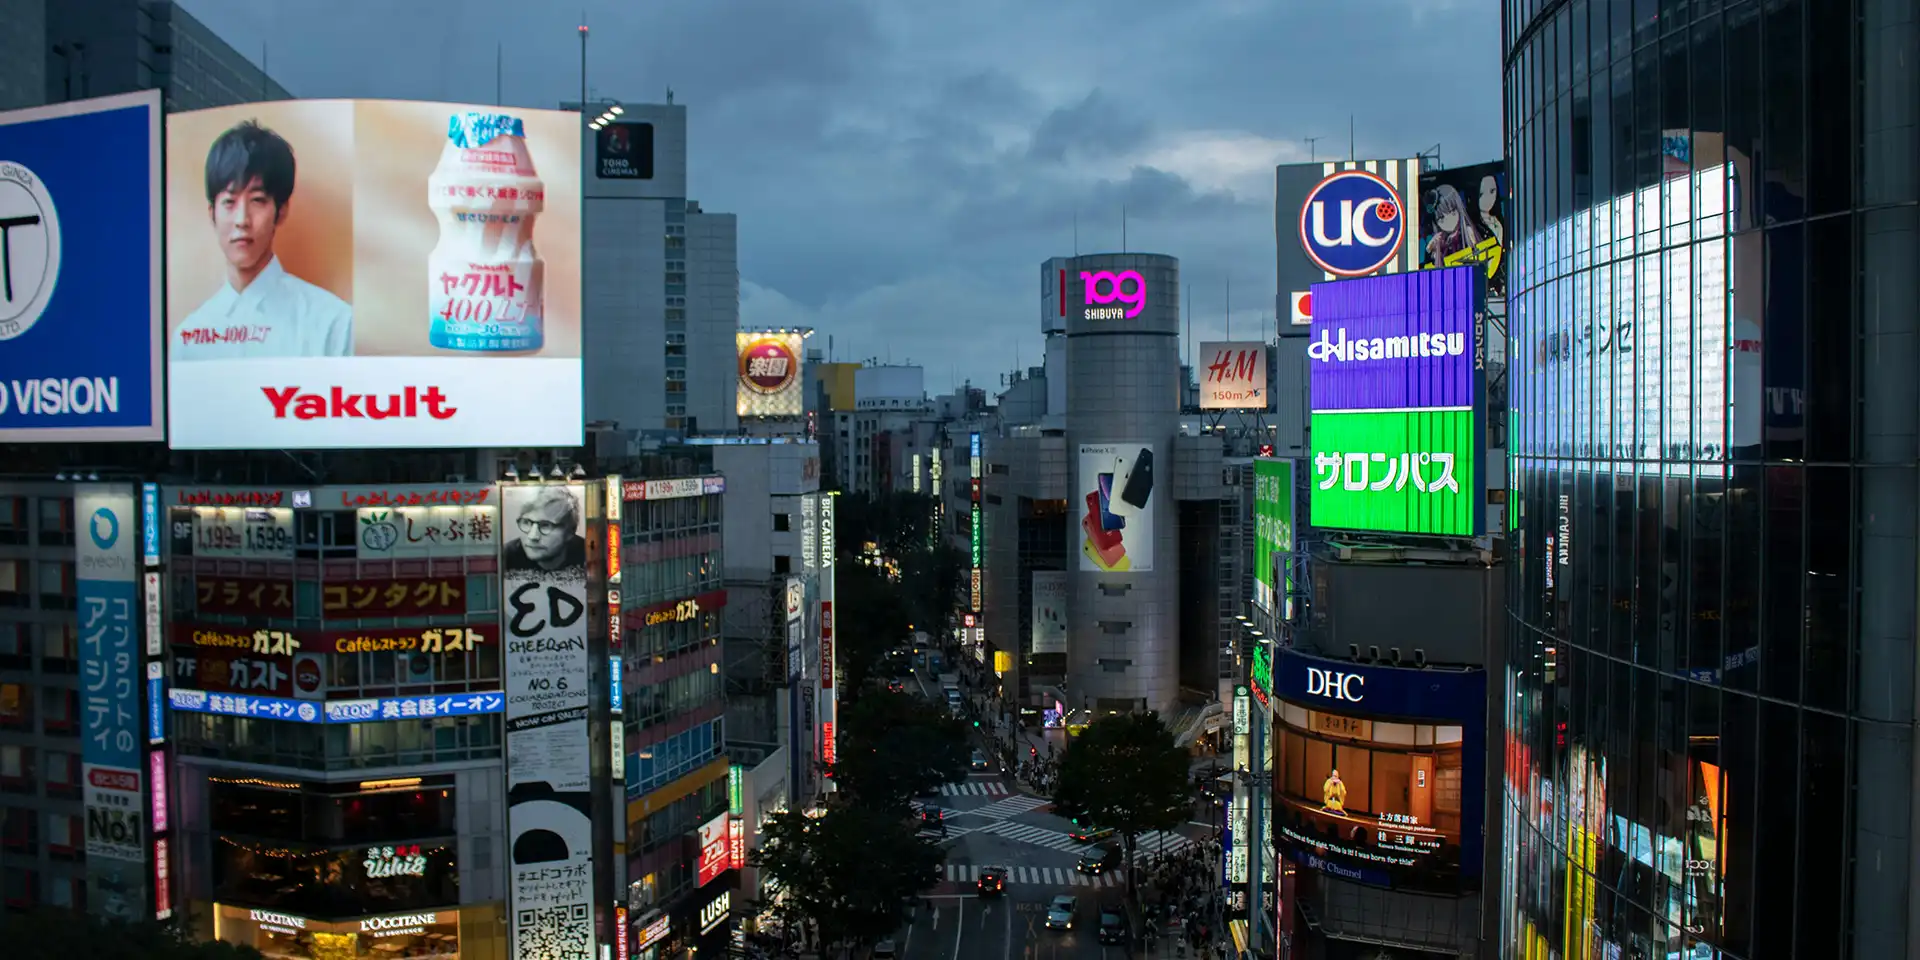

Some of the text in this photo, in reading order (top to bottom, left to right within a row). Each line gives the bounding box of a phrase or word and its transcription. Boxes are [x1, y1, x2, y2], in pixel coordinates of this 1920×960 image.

[602, 159, 629, 167] TOHO
[602, 168, 638, 176] CINEMAS
[440, 272, 524, 298] ヤクルト
[1080, 270, 1146, 318] 109
[1085, 308, 1123, 319] SHIBUYA
[1308, 328, 1464, 363] Hisamitsu
[1475, 311, 1485, 370] サロンパス
[1208, 350, 1258, 383] H&M
[12, 377, 118, 415] VISION
[260, 386, 457, 420] Yakult
[1213, 391, 1243, 400] 150m
[1315, 452, 1459, 494] サロンパス
[342, 489, 490, 506] しゃぶしゃぶバイキング
[174, 522, 192, 539] 9F
[407, 513, 492, 543] しゃぶ葉
[821, 498, 831, 568] BIC CAMERA
[83, 555, 127, 570] eyecity
[325, 581, 461, 609] コンタクト
[509, 582, 584, 637] ED
[676, 599, 699, 623] ガスト
[252, 629, 301, 656] ガスト
[421, 628, 484, 653] ガスト
[509, 636, 584, 653] SHEERAN
[85, 596, 111, 751] アイシティ
[114, 598, 134, 752] コンタクトの
[176, 657, 198, 677] 7F
[229, 657, 289, 691] ガスト
[1307, 667, 1364, 701] DHC
[174, 693, 202, 707] AEON
[209, 695, 295, 718] 英会話イーオン
[331, 703, 373, 719] AEON
[383, 696, 500, 718] 英会話イーオン
[515, 716, 540, 729] NOW
[541, 713, 557, 723] ON
[704, 839, 725, 865] アコム
[1370, 853, 1386, 863] born
[1387, 855, 1397, 865] for
[1327, 863, 1361, 879] Channel
[251, 909, 305, 928] L'OCCITANE
[360, 912, 436, 931] L'OCCITANE
[700, 890, 730, 929] LUSH
